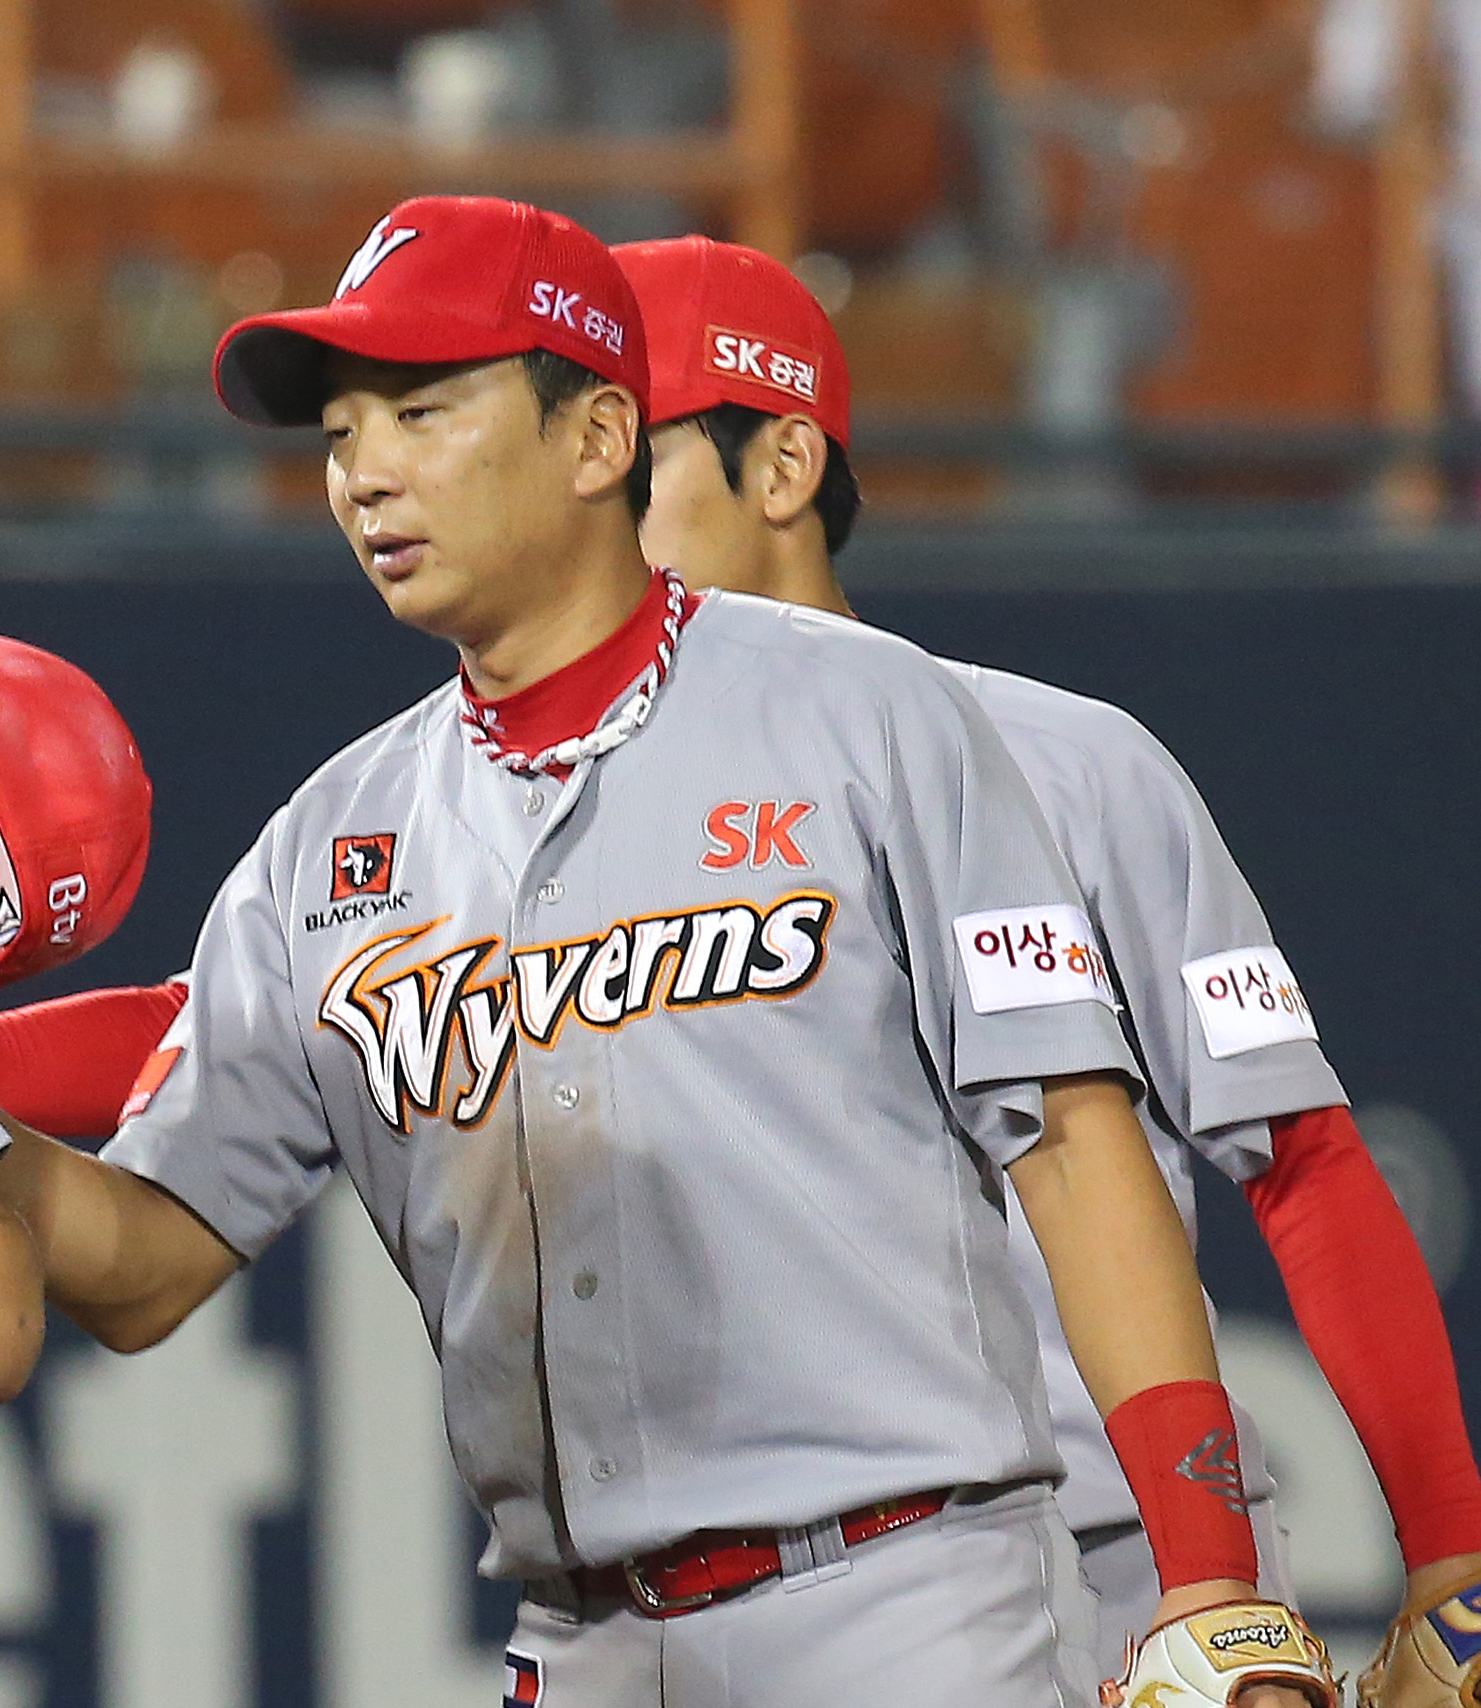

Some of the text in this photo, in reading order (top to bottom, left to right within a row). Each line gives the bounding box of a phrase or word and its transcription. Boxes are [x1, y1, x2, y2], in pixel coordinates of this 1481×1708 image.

[528, 280, 581, 330] SK
[713, 334, 766, 379] SK
[700, 800, 818, 872] SK
[318, 888, 838, 1136] Wyverns
